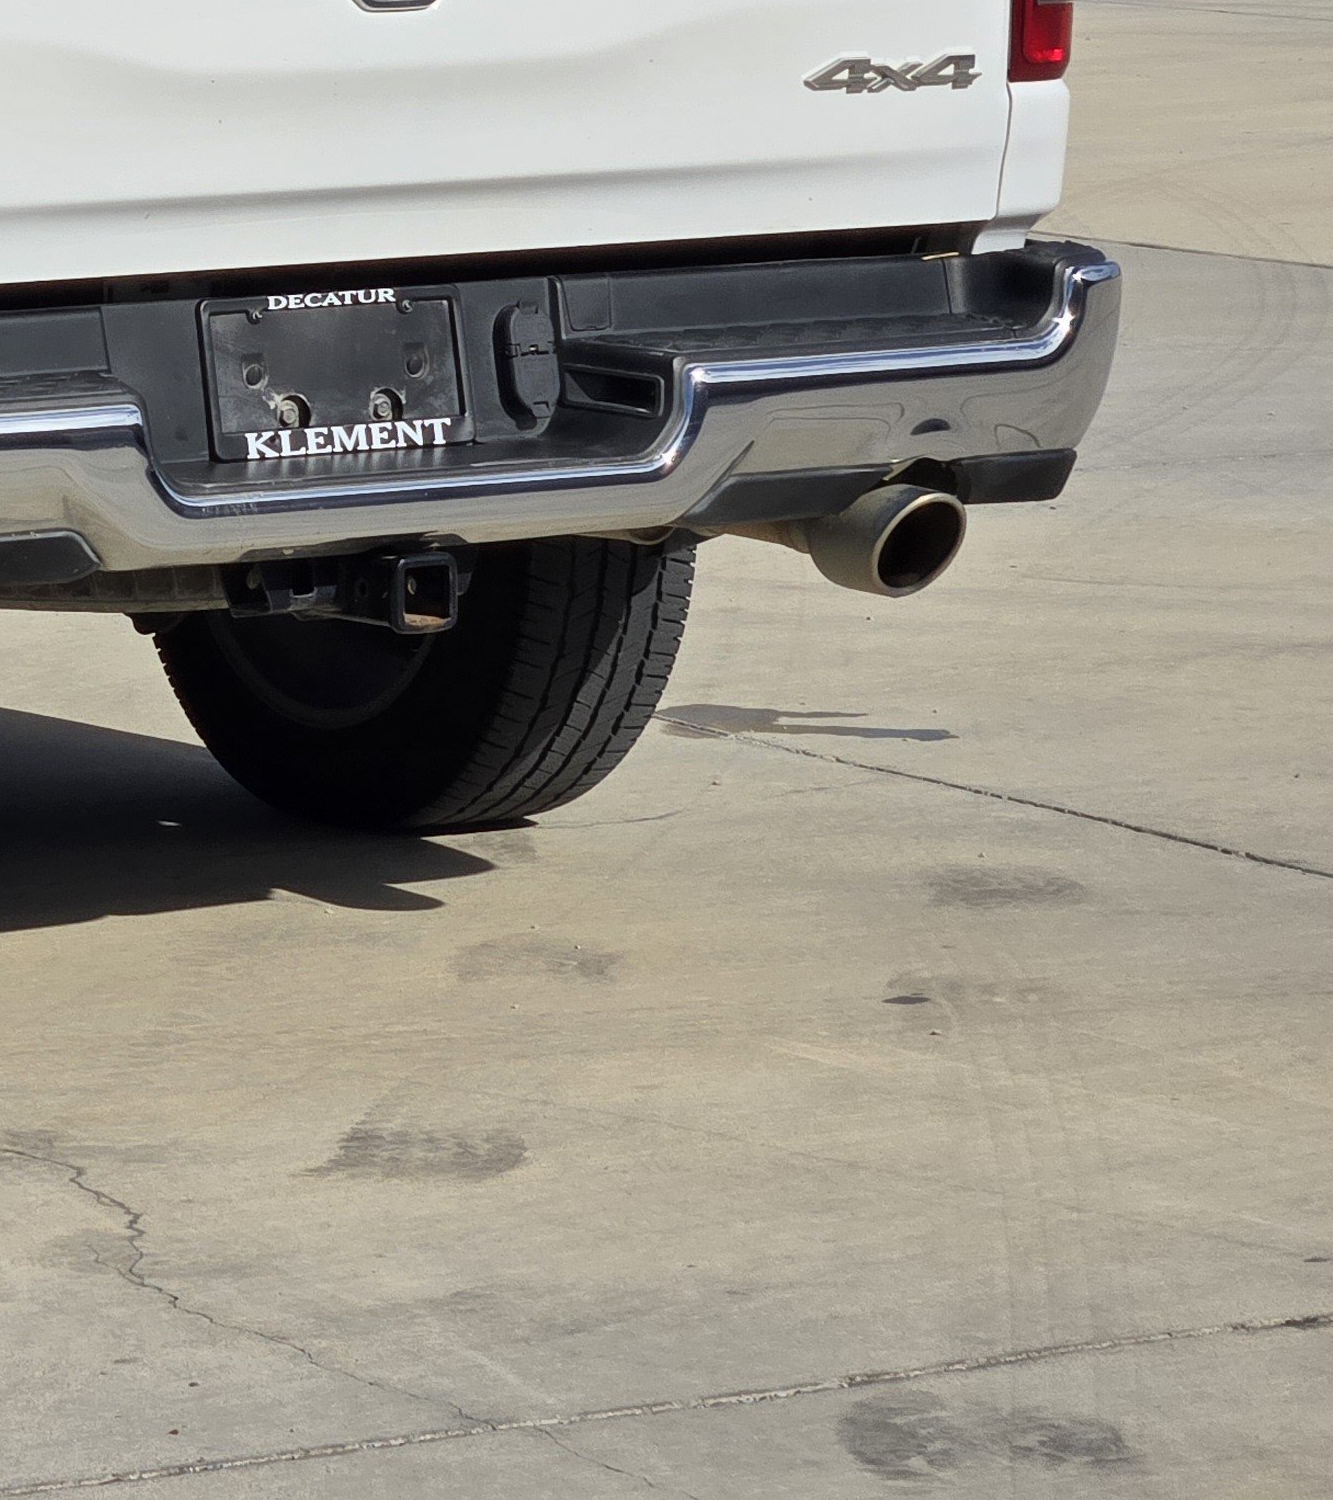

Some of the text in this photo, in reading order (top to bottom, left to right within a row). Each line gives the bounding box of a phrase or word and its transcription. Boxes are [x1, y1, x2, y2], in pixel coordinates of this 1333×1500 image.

[803, 53, 982, 94] 4x4
[267, 287, 396, 311] DECATUR
[245, 418, 451, 460] KLEMENT
